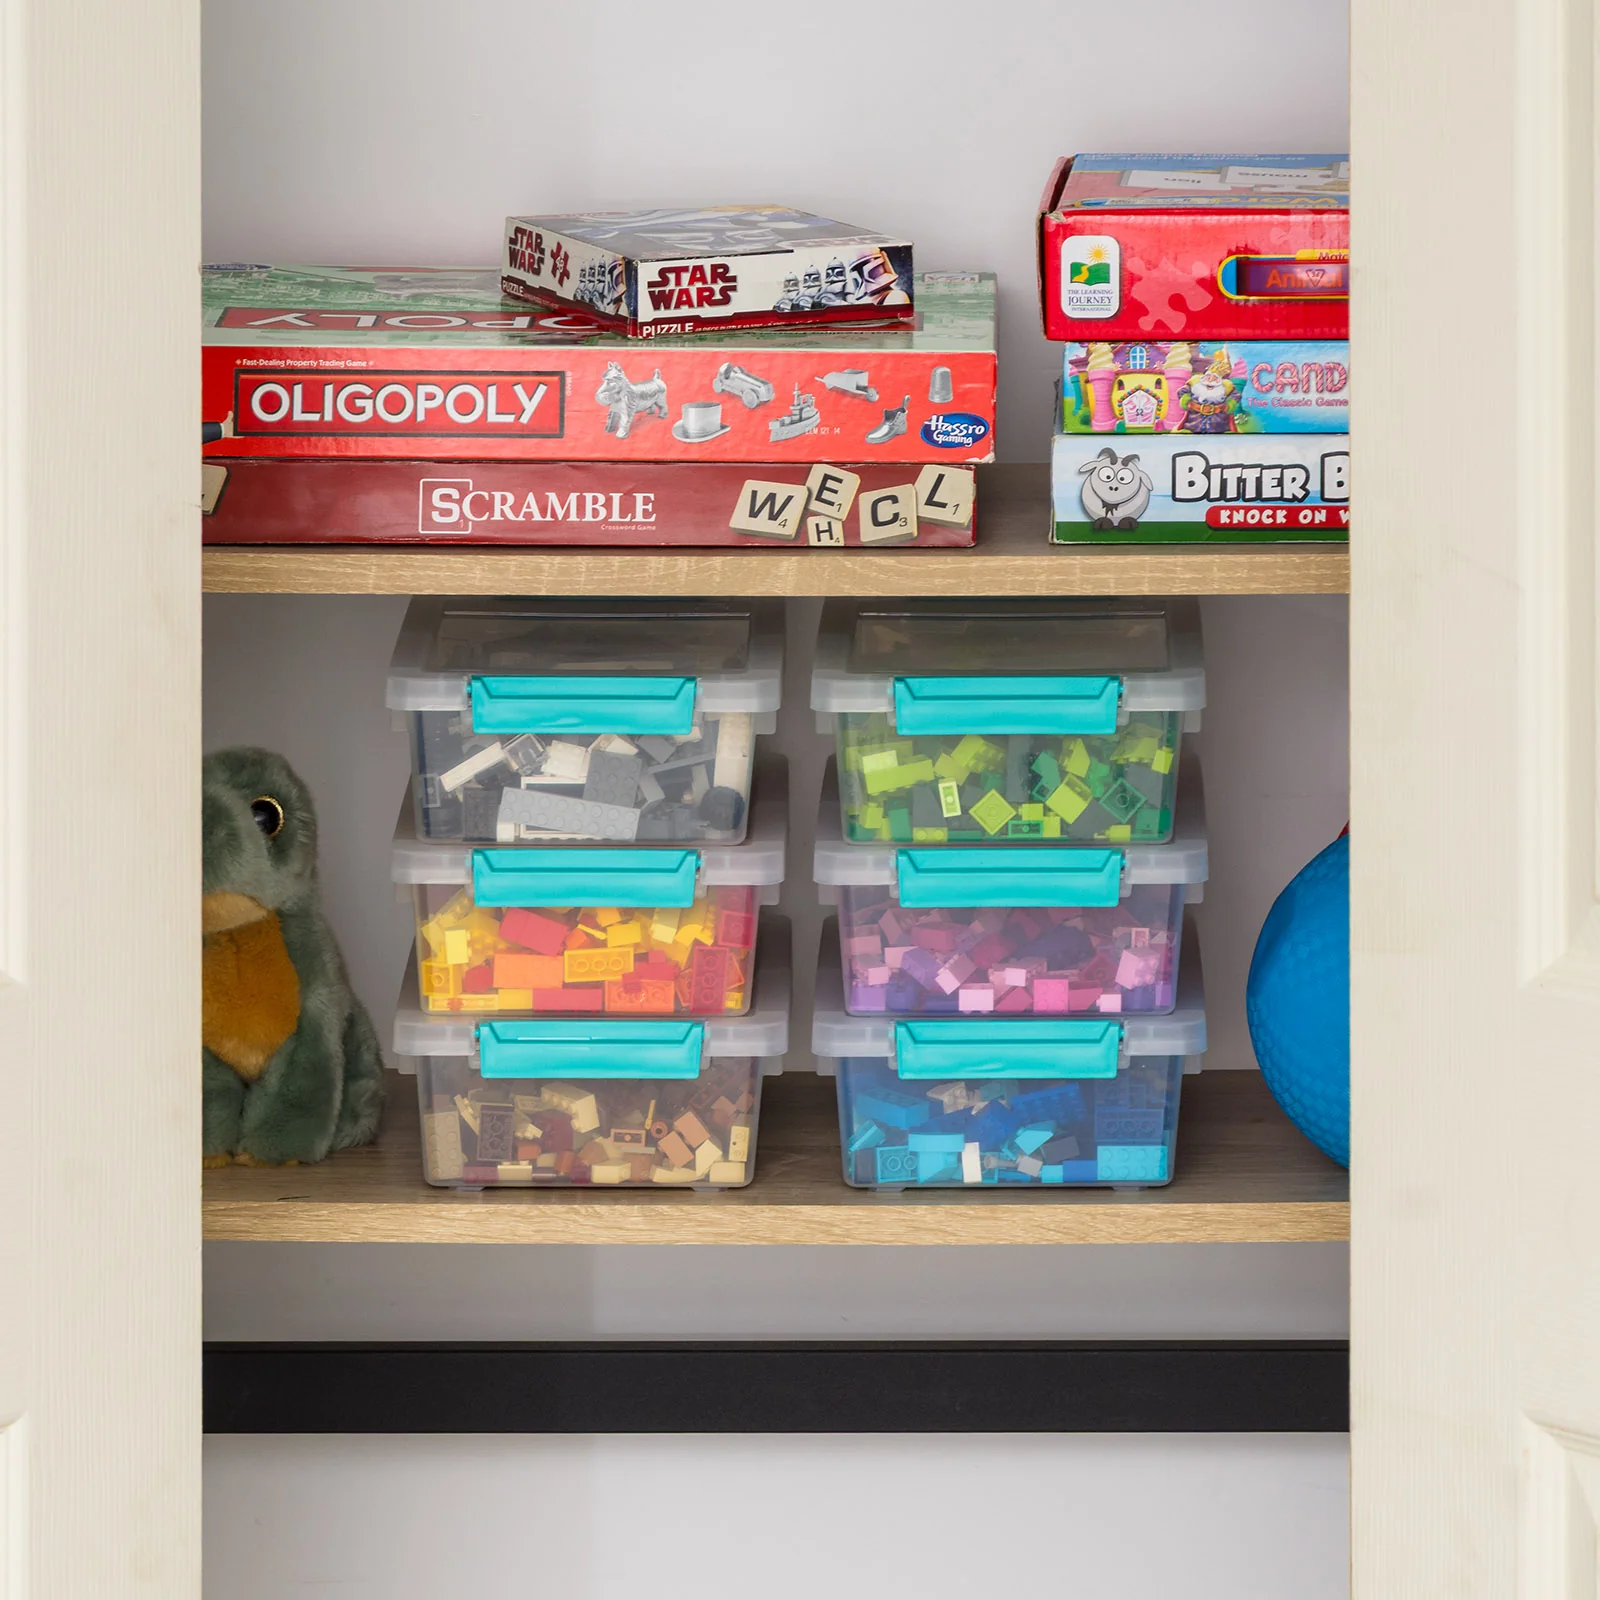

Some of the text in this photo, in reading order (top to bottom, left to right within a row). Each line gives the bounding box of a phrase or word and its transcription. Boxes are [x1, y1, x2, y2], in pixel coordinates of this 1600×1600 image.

[509, 226, 545, 256] STAR
[508, 246, 545, 276] WARS
[647, 263, 737, 289] STAR
[502, 280, 525, 298] PUZZLE
[647, 285, 737, 311] WARS
[1068, 296, 1112, 306] JOURNEY
[242, 359, 285, 367] Fast-Dealing
[286, 359, 318, 367] Property
[251, 382, 548, 424] OLIGOPOLY
[1247, 397, 1349, 407] The Classic Game
[924, 415, 985, 436] Hassro
[933, 430, 973, 447] Gaming
[431, 487, 657, 523] SCRAMBLE
[1220, 509, 1288, 524] KNOCK
[1298, 509, 1327, 524] ON
